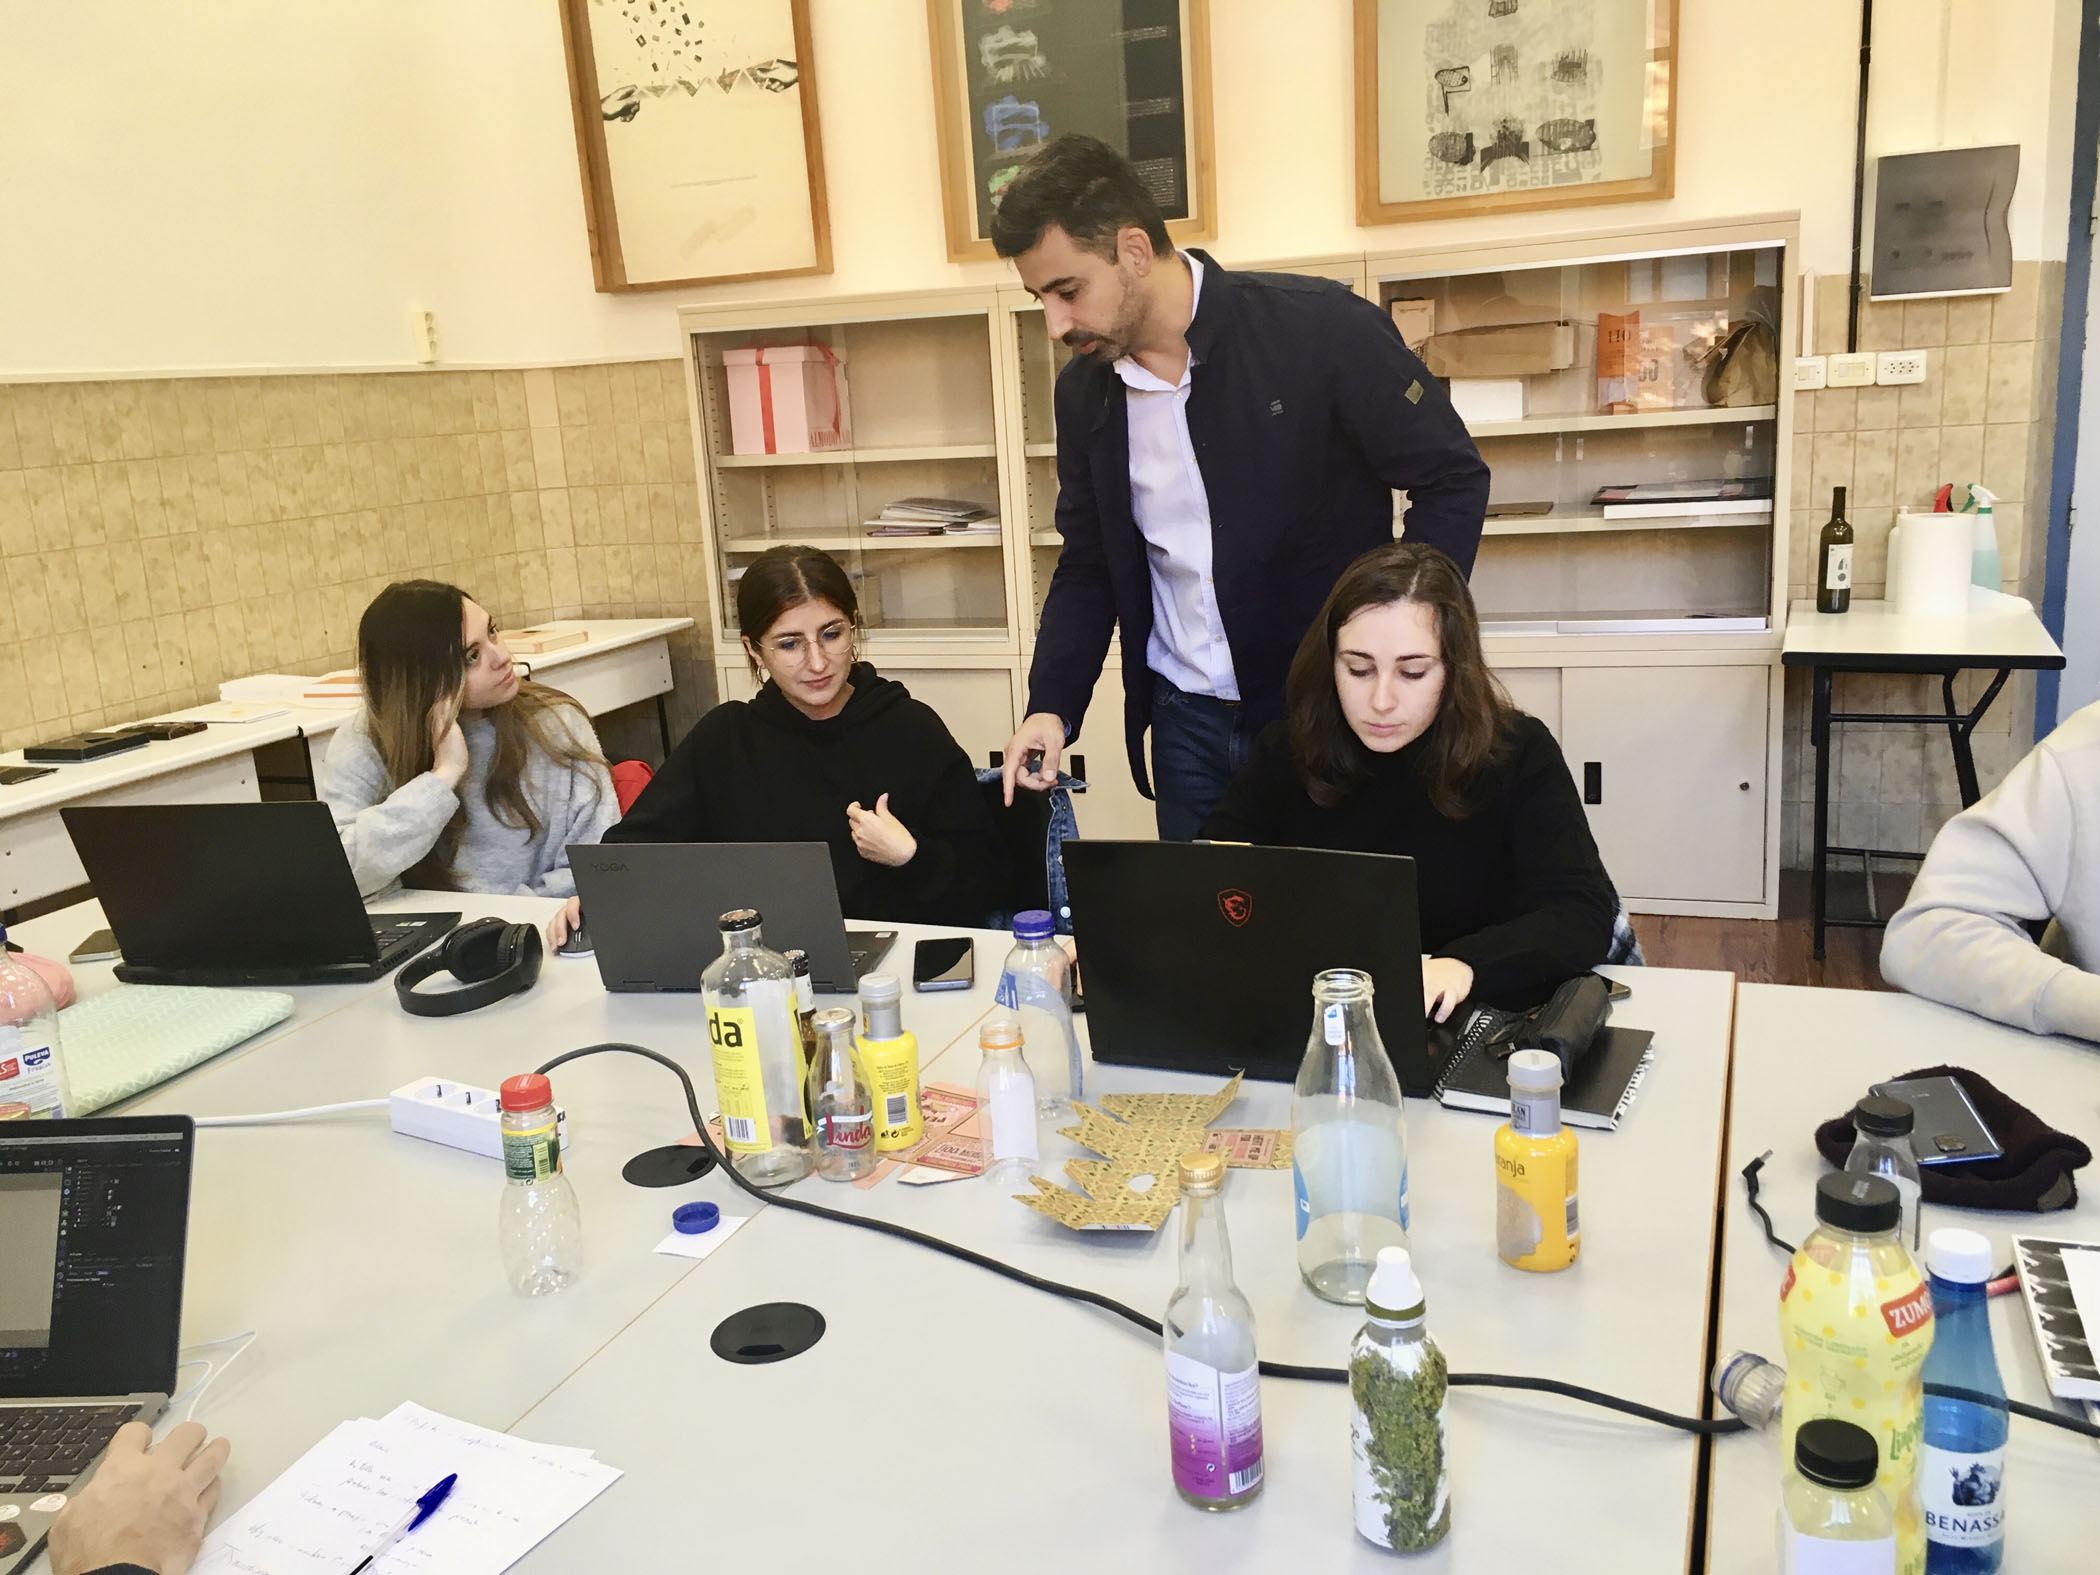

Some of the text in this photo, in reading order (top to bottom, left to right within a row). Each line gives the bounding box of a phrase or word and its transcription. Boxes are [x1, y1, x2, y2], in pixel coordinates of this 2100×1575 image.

[590, 863, 630, 872] YOGA
[25, 1049, 49, 1061] PULEVA
[824, 1105, 872, 1149] Linda
[1495, 1153, 1526, 1177] ranja
